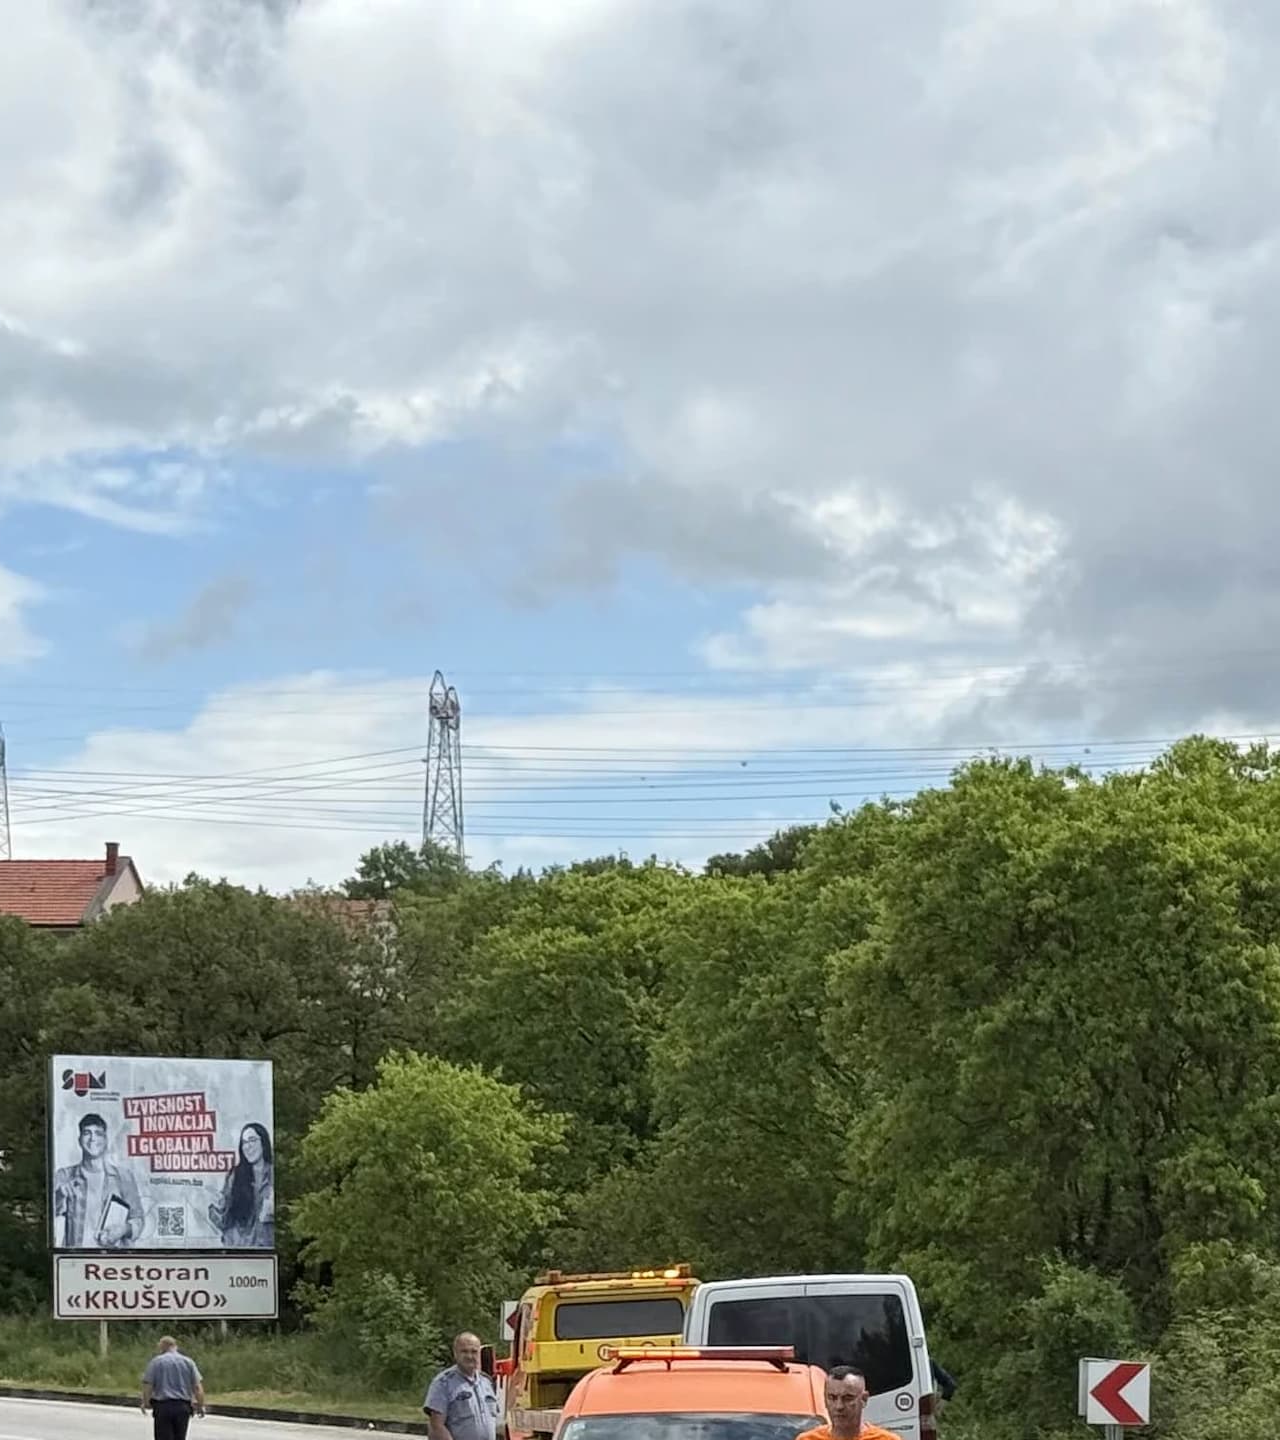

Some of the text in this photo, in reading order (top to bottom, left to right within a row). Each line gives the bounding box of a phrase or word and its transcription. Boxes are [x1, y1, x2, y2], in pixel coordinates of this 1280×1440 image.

[127, 1095, 202, 1116] IZVRSNOST
[143, 1114, 214, 1132] INOVACIJA
[131, 1136, 211, 1154] I GLOBALNA
[85, 1264, 209, 1281] Restoran
[228, 1276, 269, 1289] 1000m
[67, 1284, 227, 1310] «KRUŠEVO»
